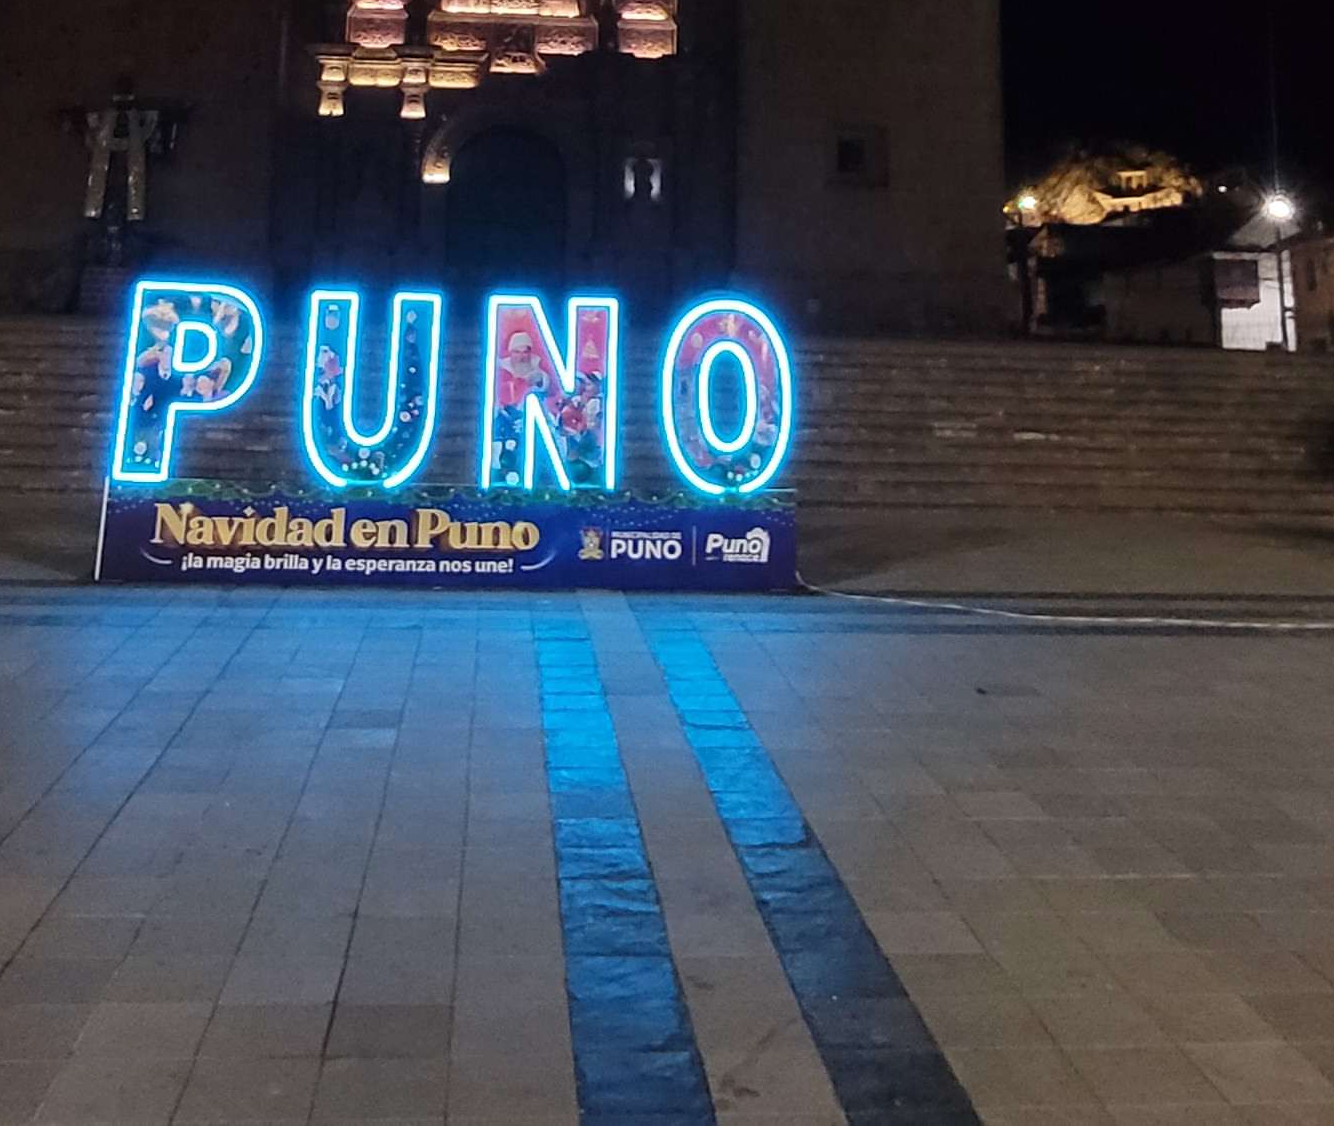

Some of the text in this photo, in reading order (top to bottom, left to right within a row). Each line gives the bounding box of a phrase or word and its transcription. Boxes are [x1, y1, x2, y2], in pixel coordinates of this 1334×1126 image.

[111, 280, 793, 495] PUNO
[150, 502, 540, 551] Navidad en Puno
[610, 539, 683, 560] PUNO
[705, 533, 762, 554] Puno
[181, 552, 514, 575] ¡la magia brilla y la esperanza nos une!
